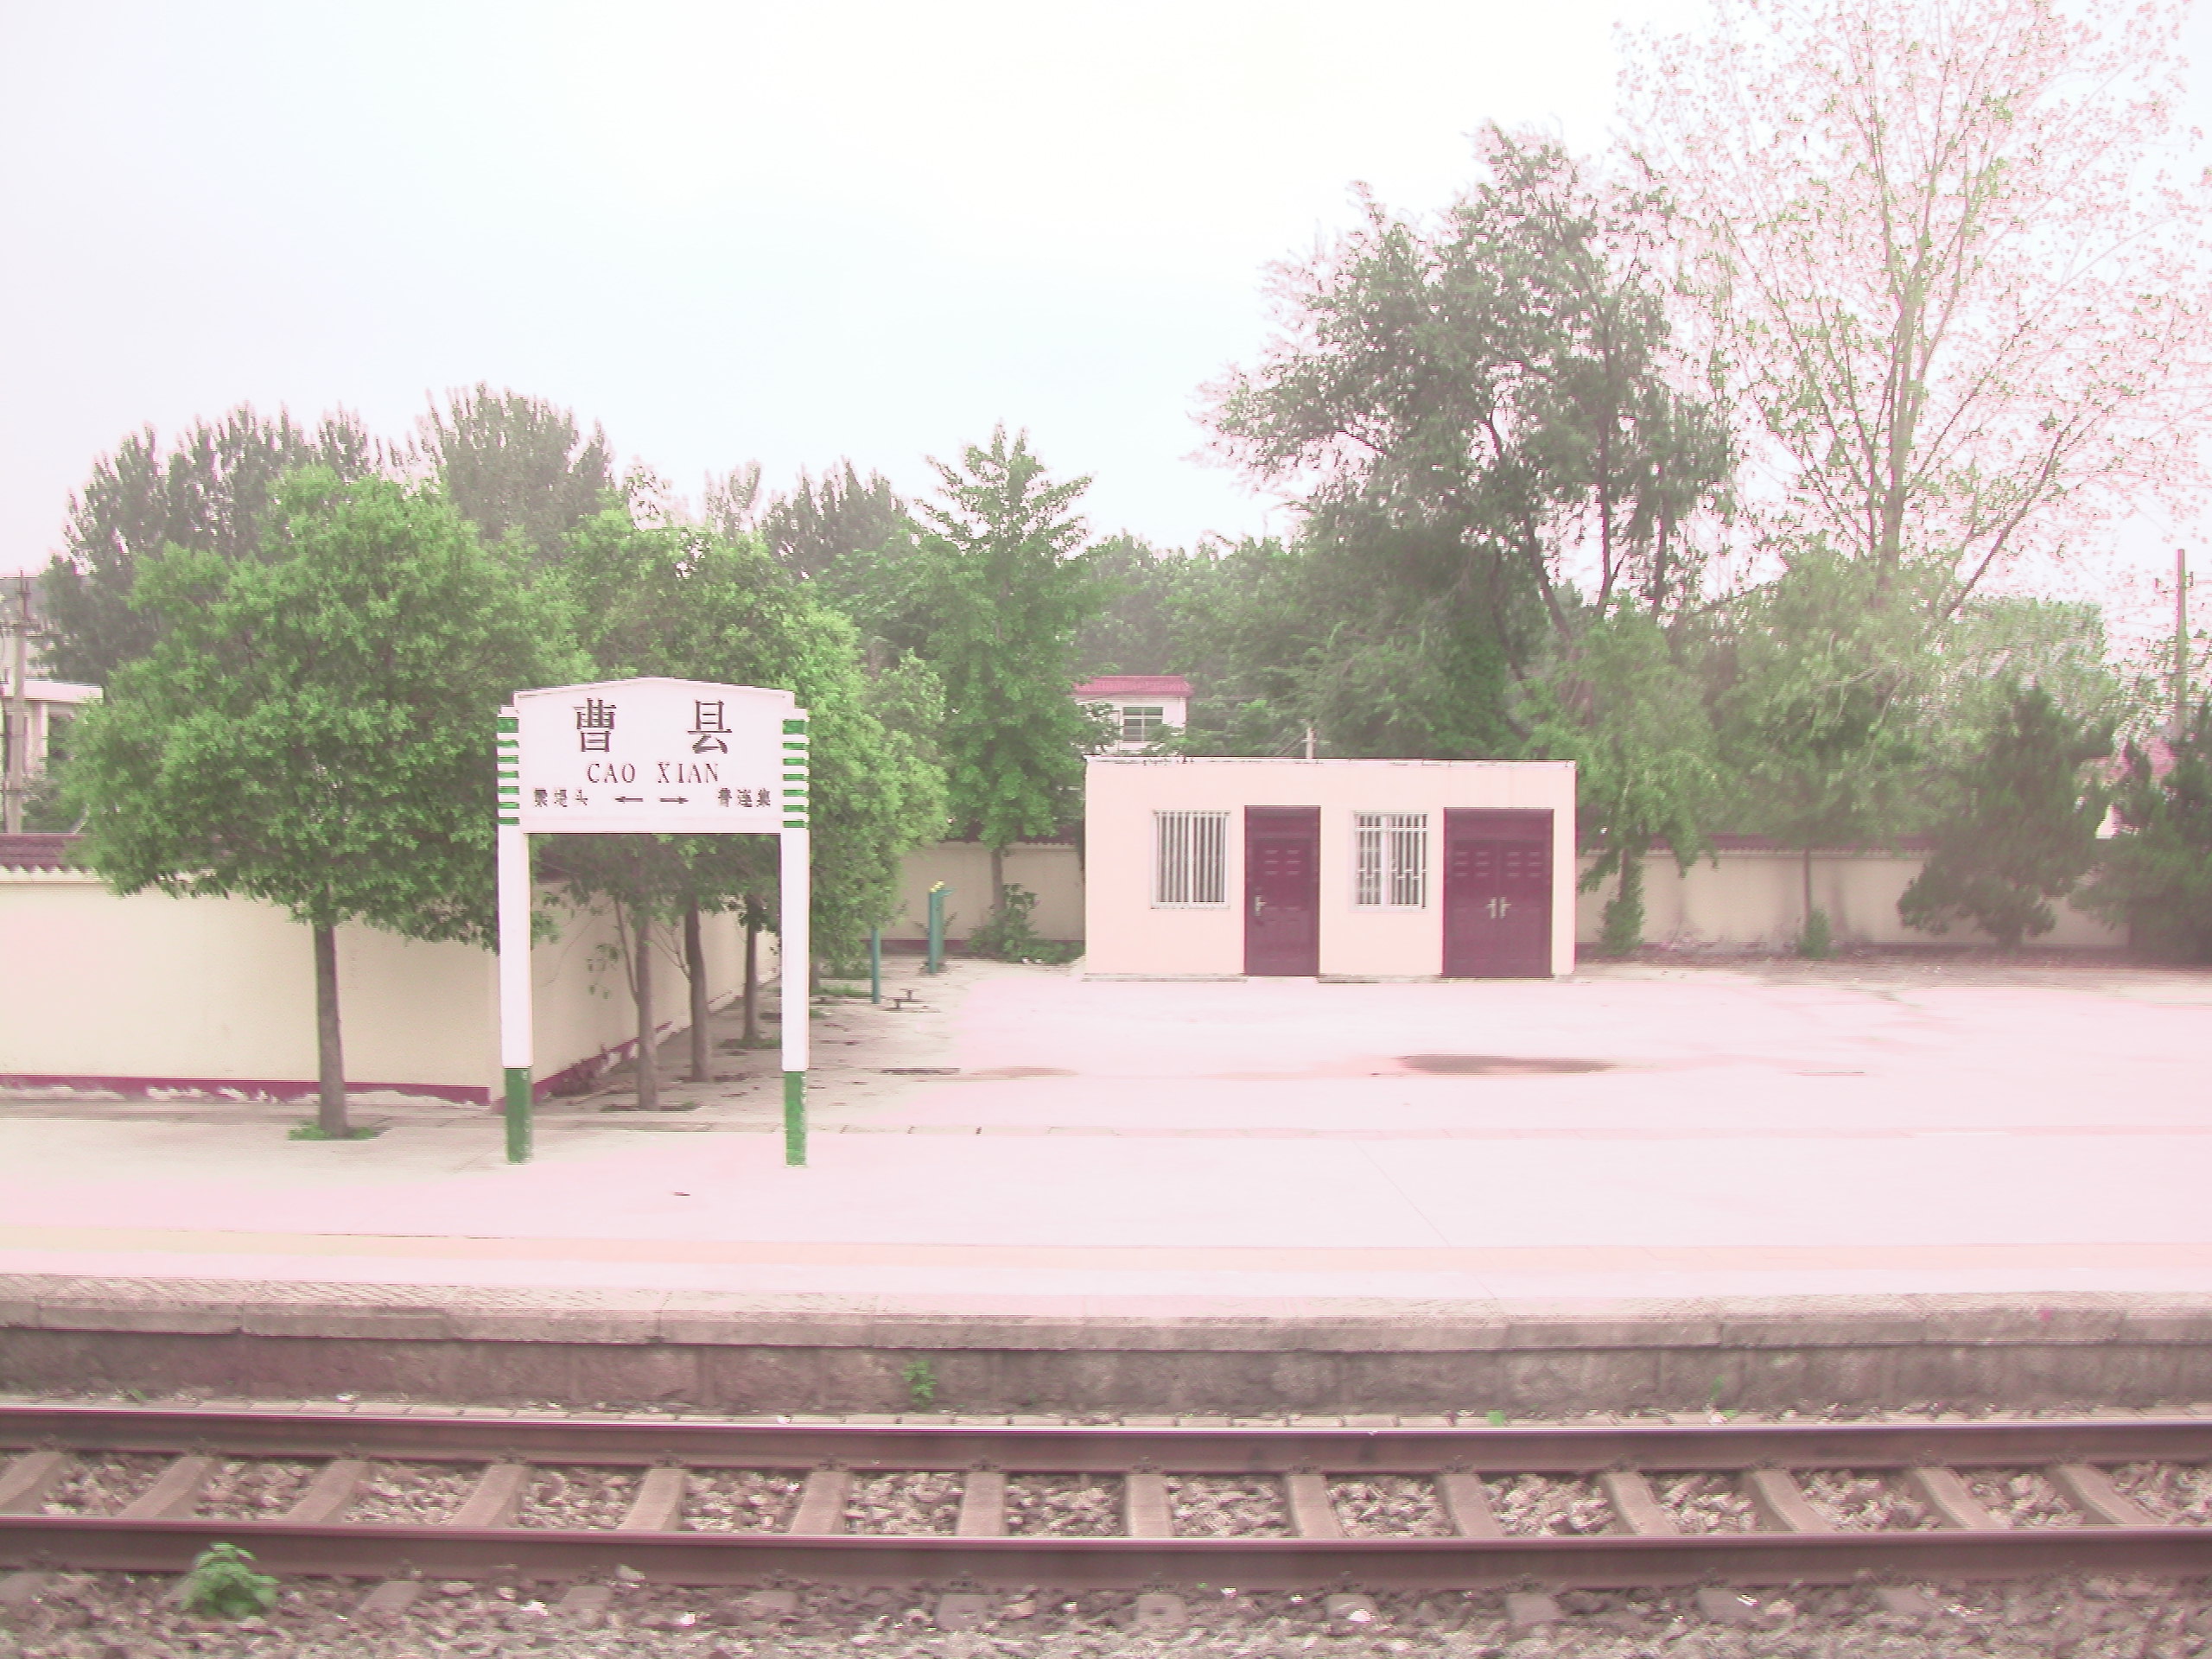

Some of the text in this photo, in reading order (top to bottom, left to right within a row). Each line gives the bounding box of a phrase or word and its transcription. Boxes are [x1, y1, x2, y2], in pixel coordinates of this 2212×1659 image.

[573, 697, 733, 754] 曹县
[587, 761, 719, 784] CAO XIAN
